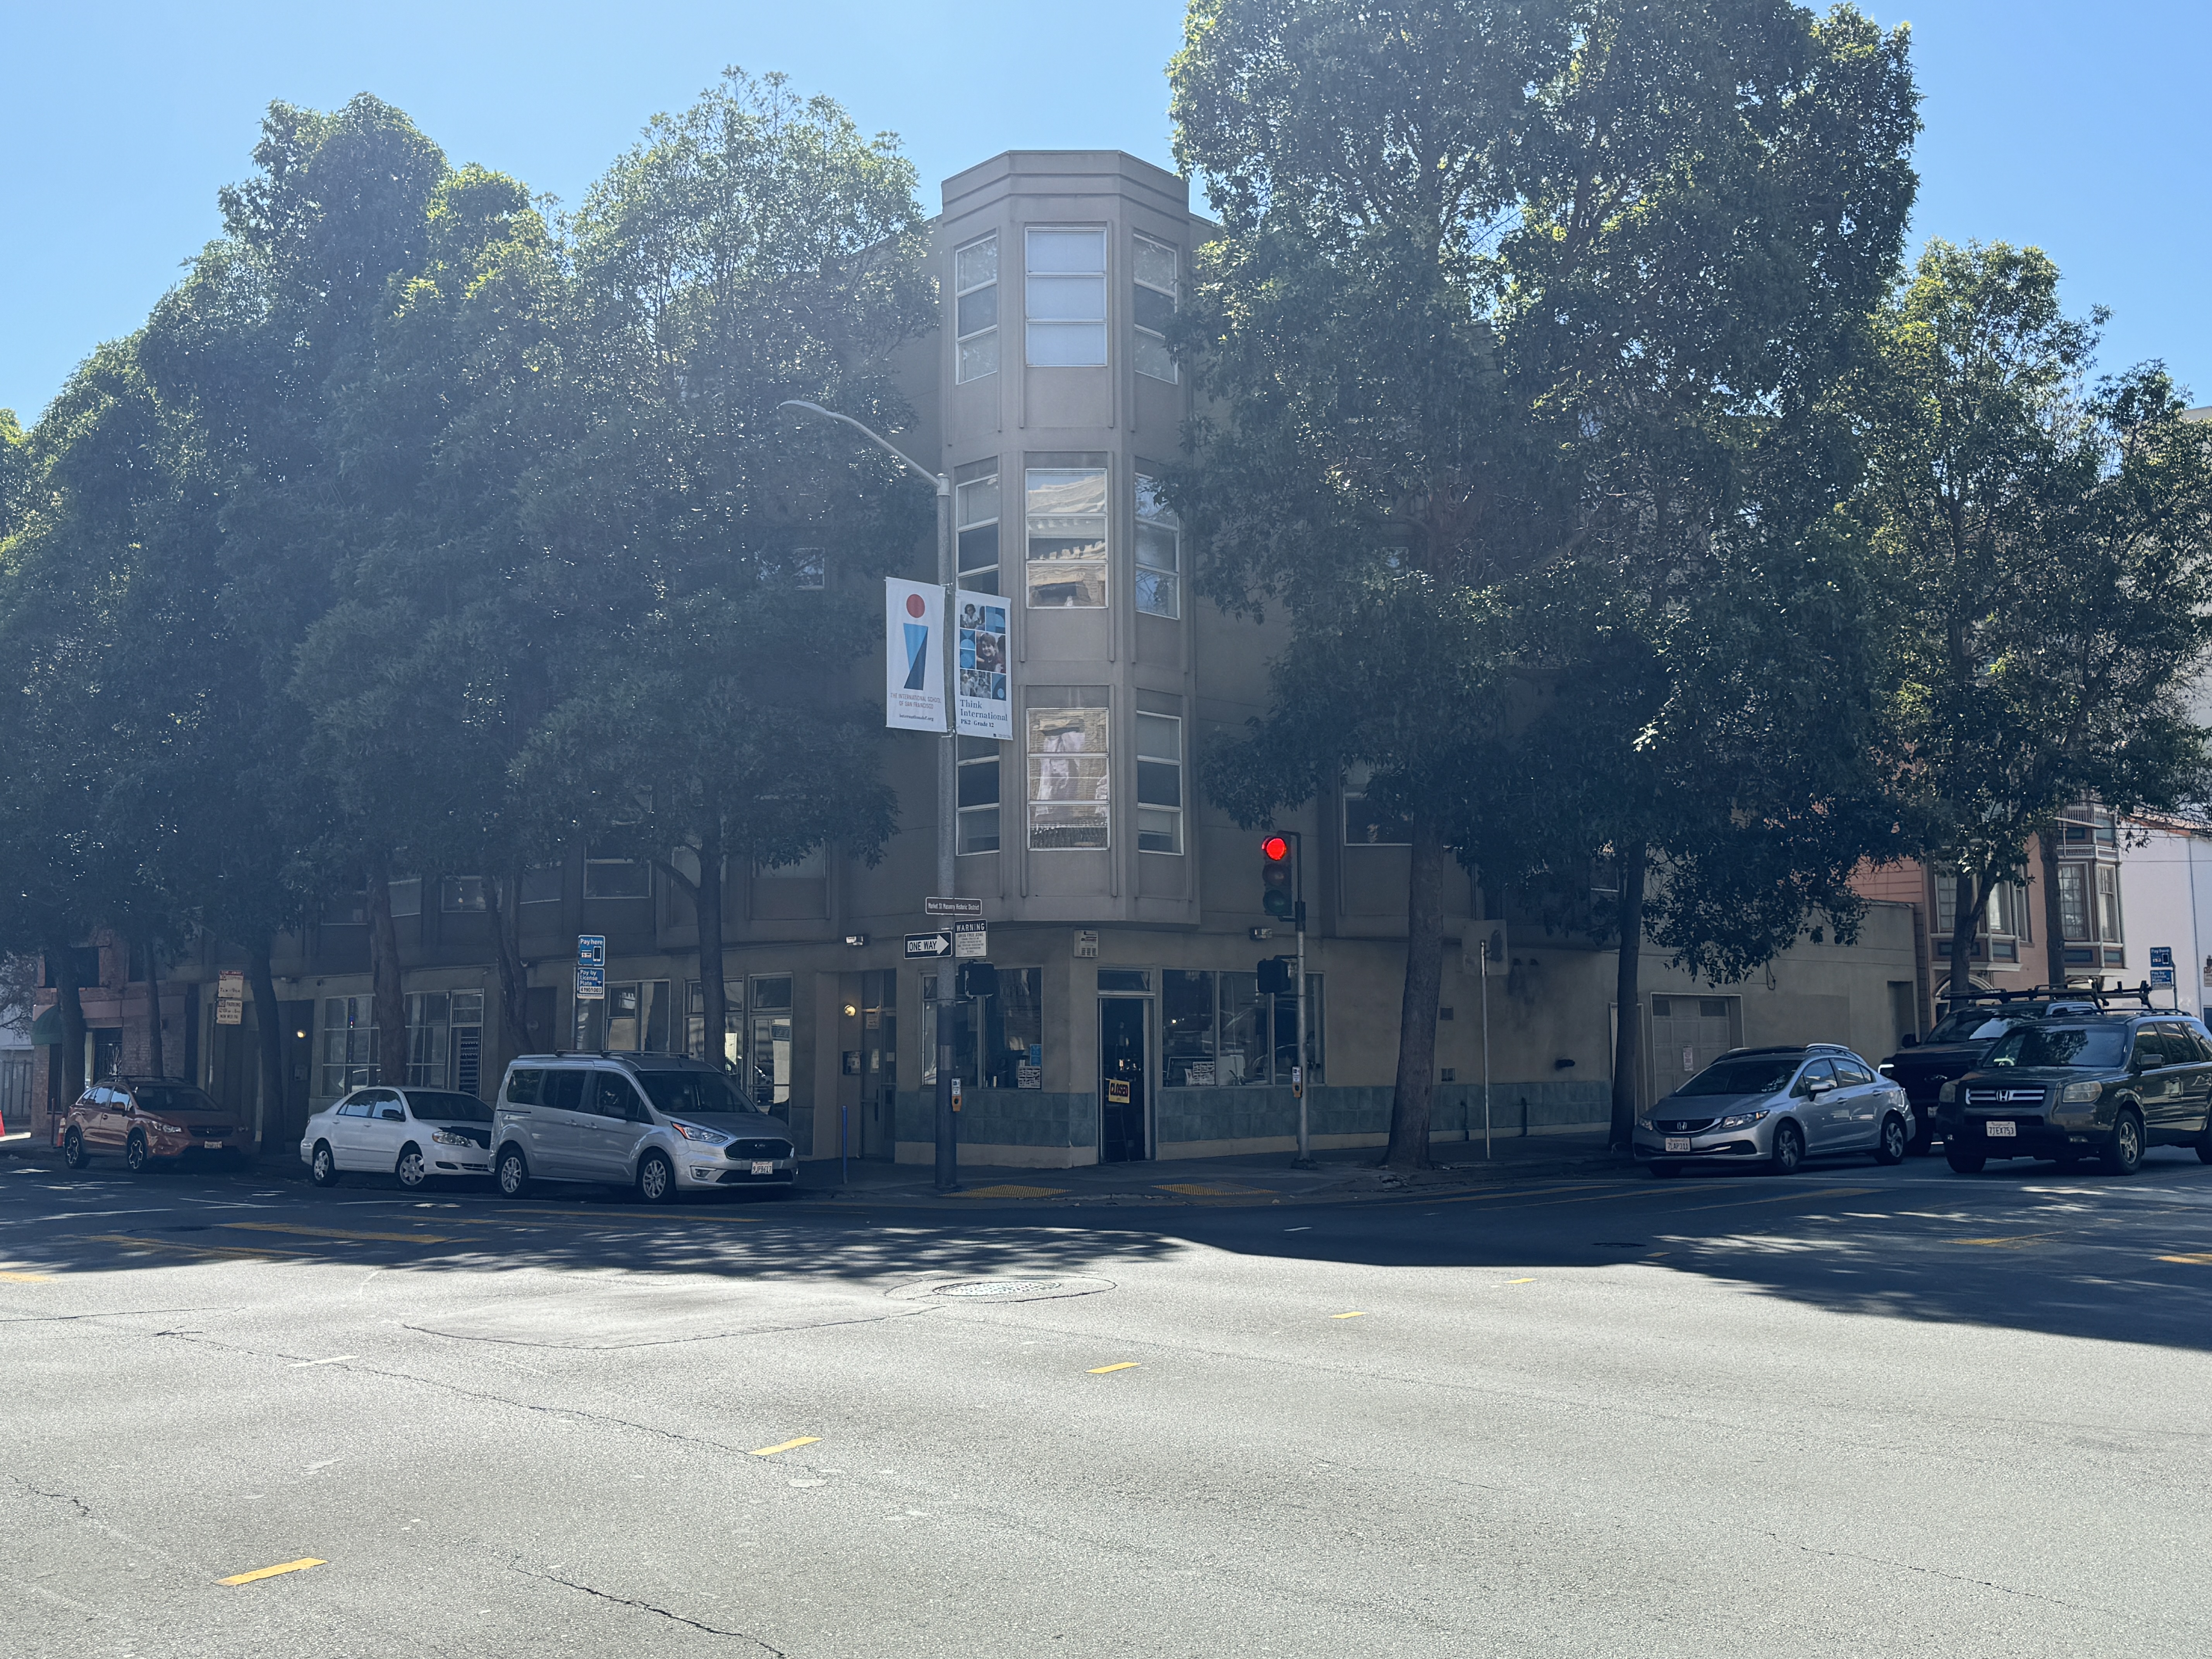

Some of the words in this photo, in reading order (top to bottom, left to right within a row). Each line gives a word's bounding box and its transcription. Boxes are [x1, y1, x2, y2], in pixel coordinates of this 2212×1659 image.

[960, 699, 982, 709] Think
[960, 709, 1008, 721] International
[957, 923, 985, 932] WARNING
[909, 941, 922, 951] ONE
[923, 940, 937, 950] WAY
[1110, 1082, 1128, 1097] CLOSED
